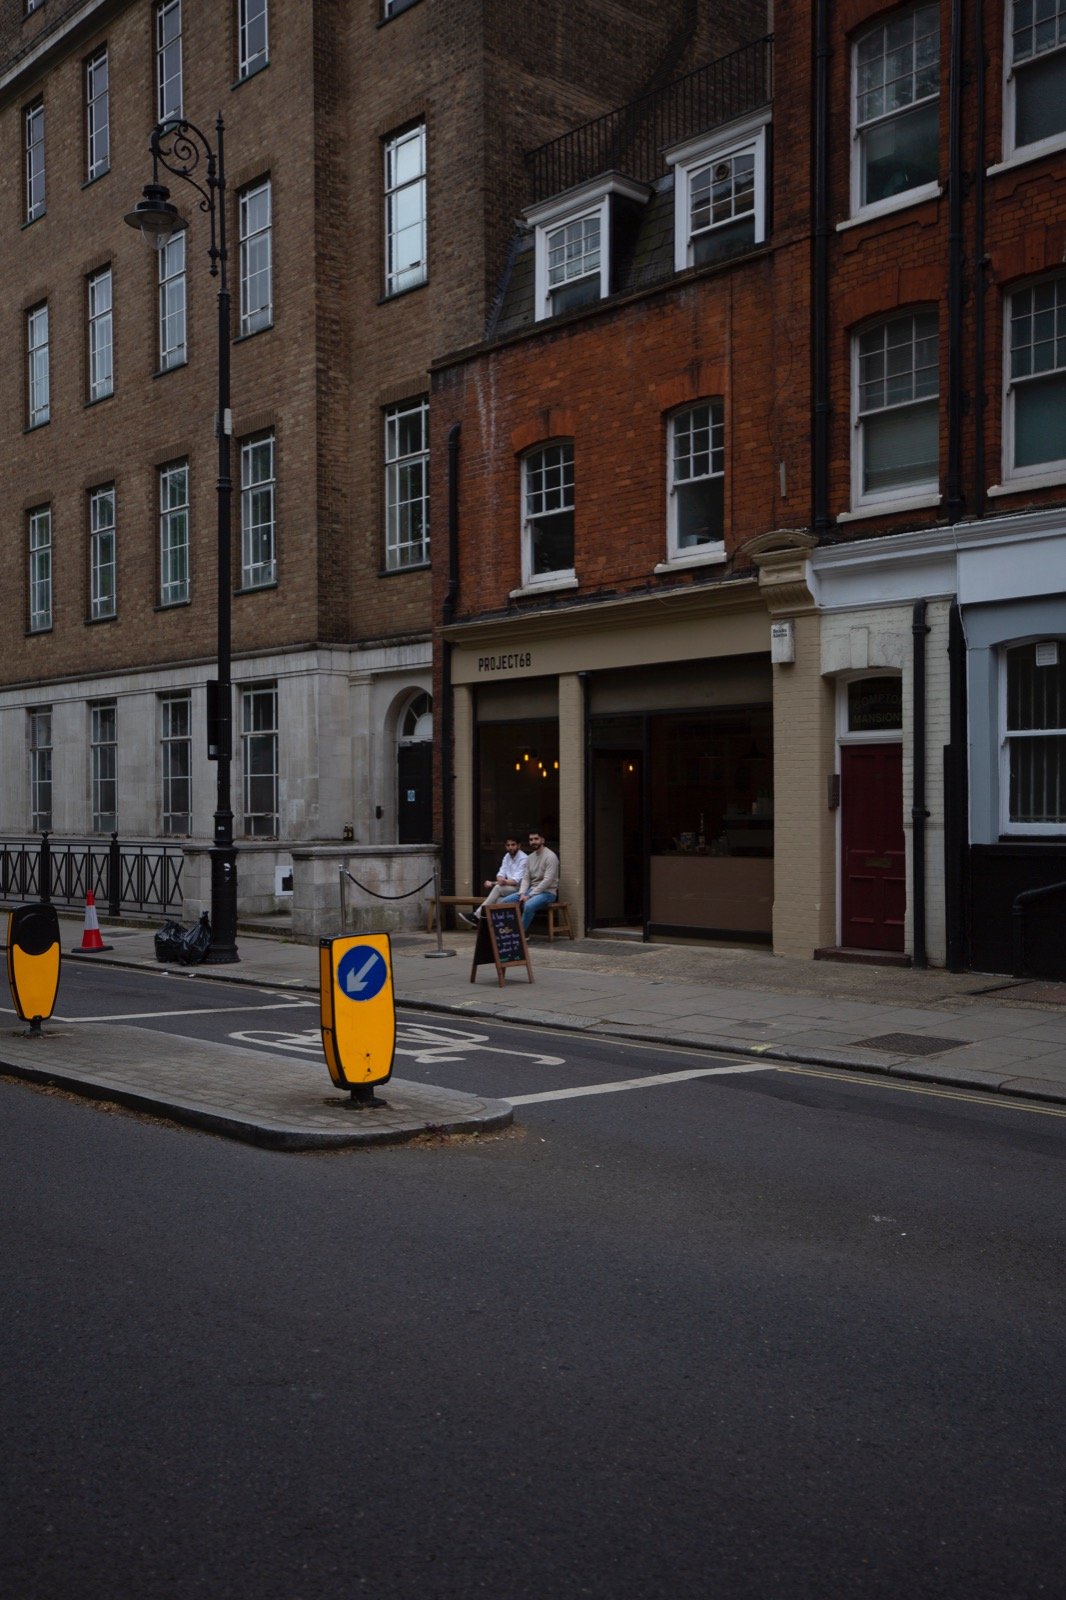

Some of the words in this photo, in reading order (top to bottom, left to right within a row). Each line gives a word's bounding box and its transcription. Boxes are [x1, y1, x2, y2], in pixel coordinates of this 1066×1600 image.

[478, 652, 532, 672] PROJECT68
[855, 693, 901, 710] COMPTO
[854, 712, 902, 723] MANSION
